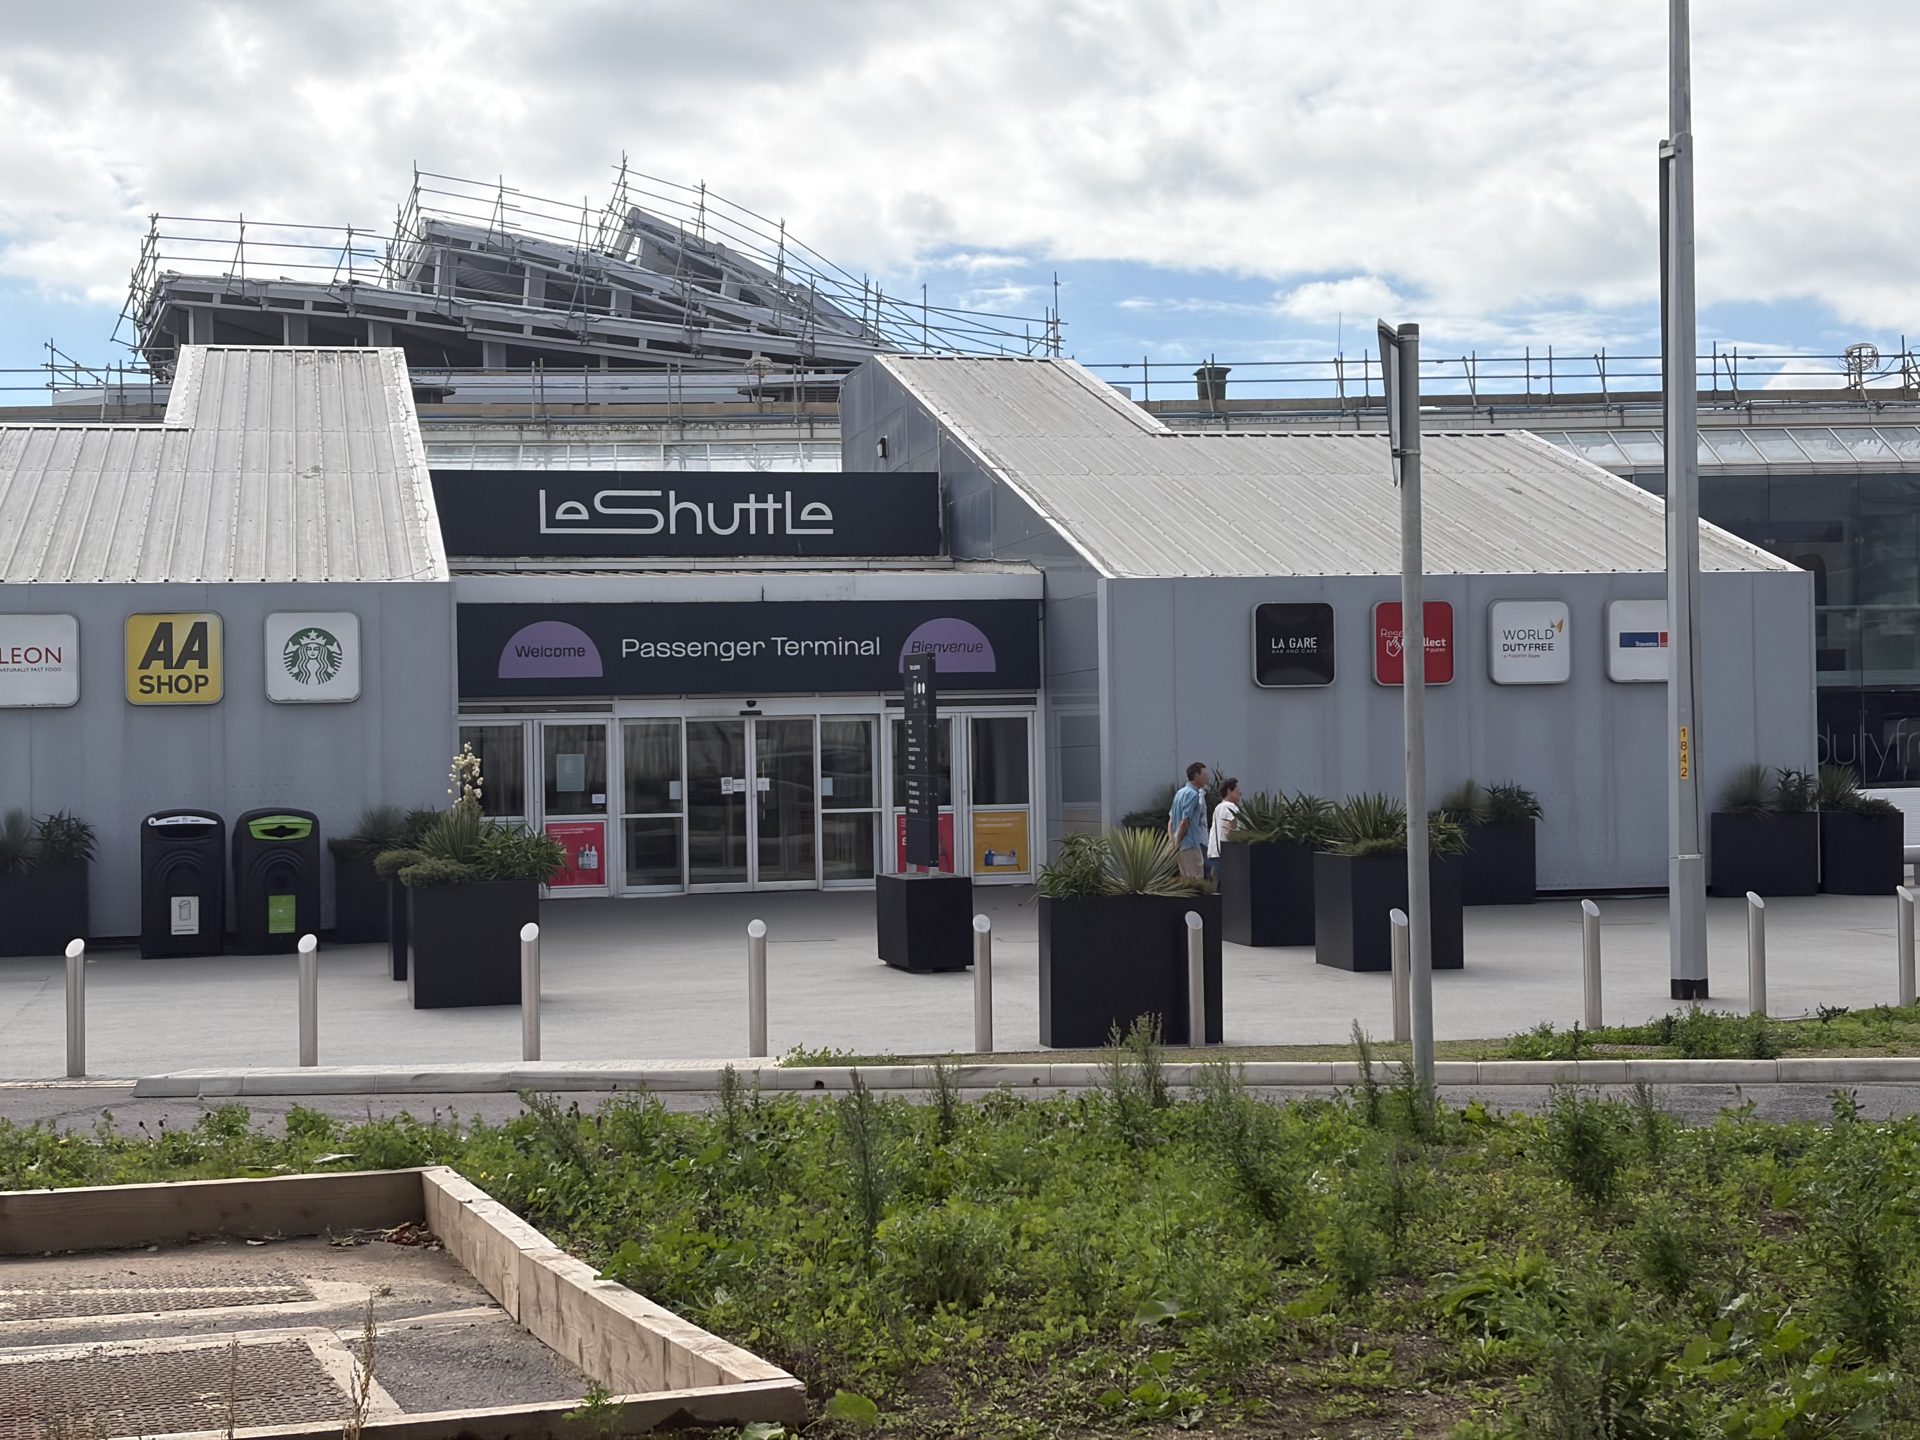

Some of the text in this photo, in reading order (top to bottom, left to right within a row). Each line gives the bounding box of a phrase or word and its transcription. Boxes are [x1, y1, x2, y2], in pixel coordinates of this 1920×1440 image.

[539, 489, 834, 535] LeShuttle
[1271, 637, 1318, 649] LA GARE
[1502, 628, 1555, 641] WORLD
[0, 646, 62, 664] LEON
[138, 621, 208, 670] AA
[515, 645, 586, 659] Welcome
[621, 636, 881, 662] Passenger Terminal
[911, 640, 984, 654] Bienvenue
[138, 674, 210, 694] SHOP
[1680, 727, 1688, 778] 1842
